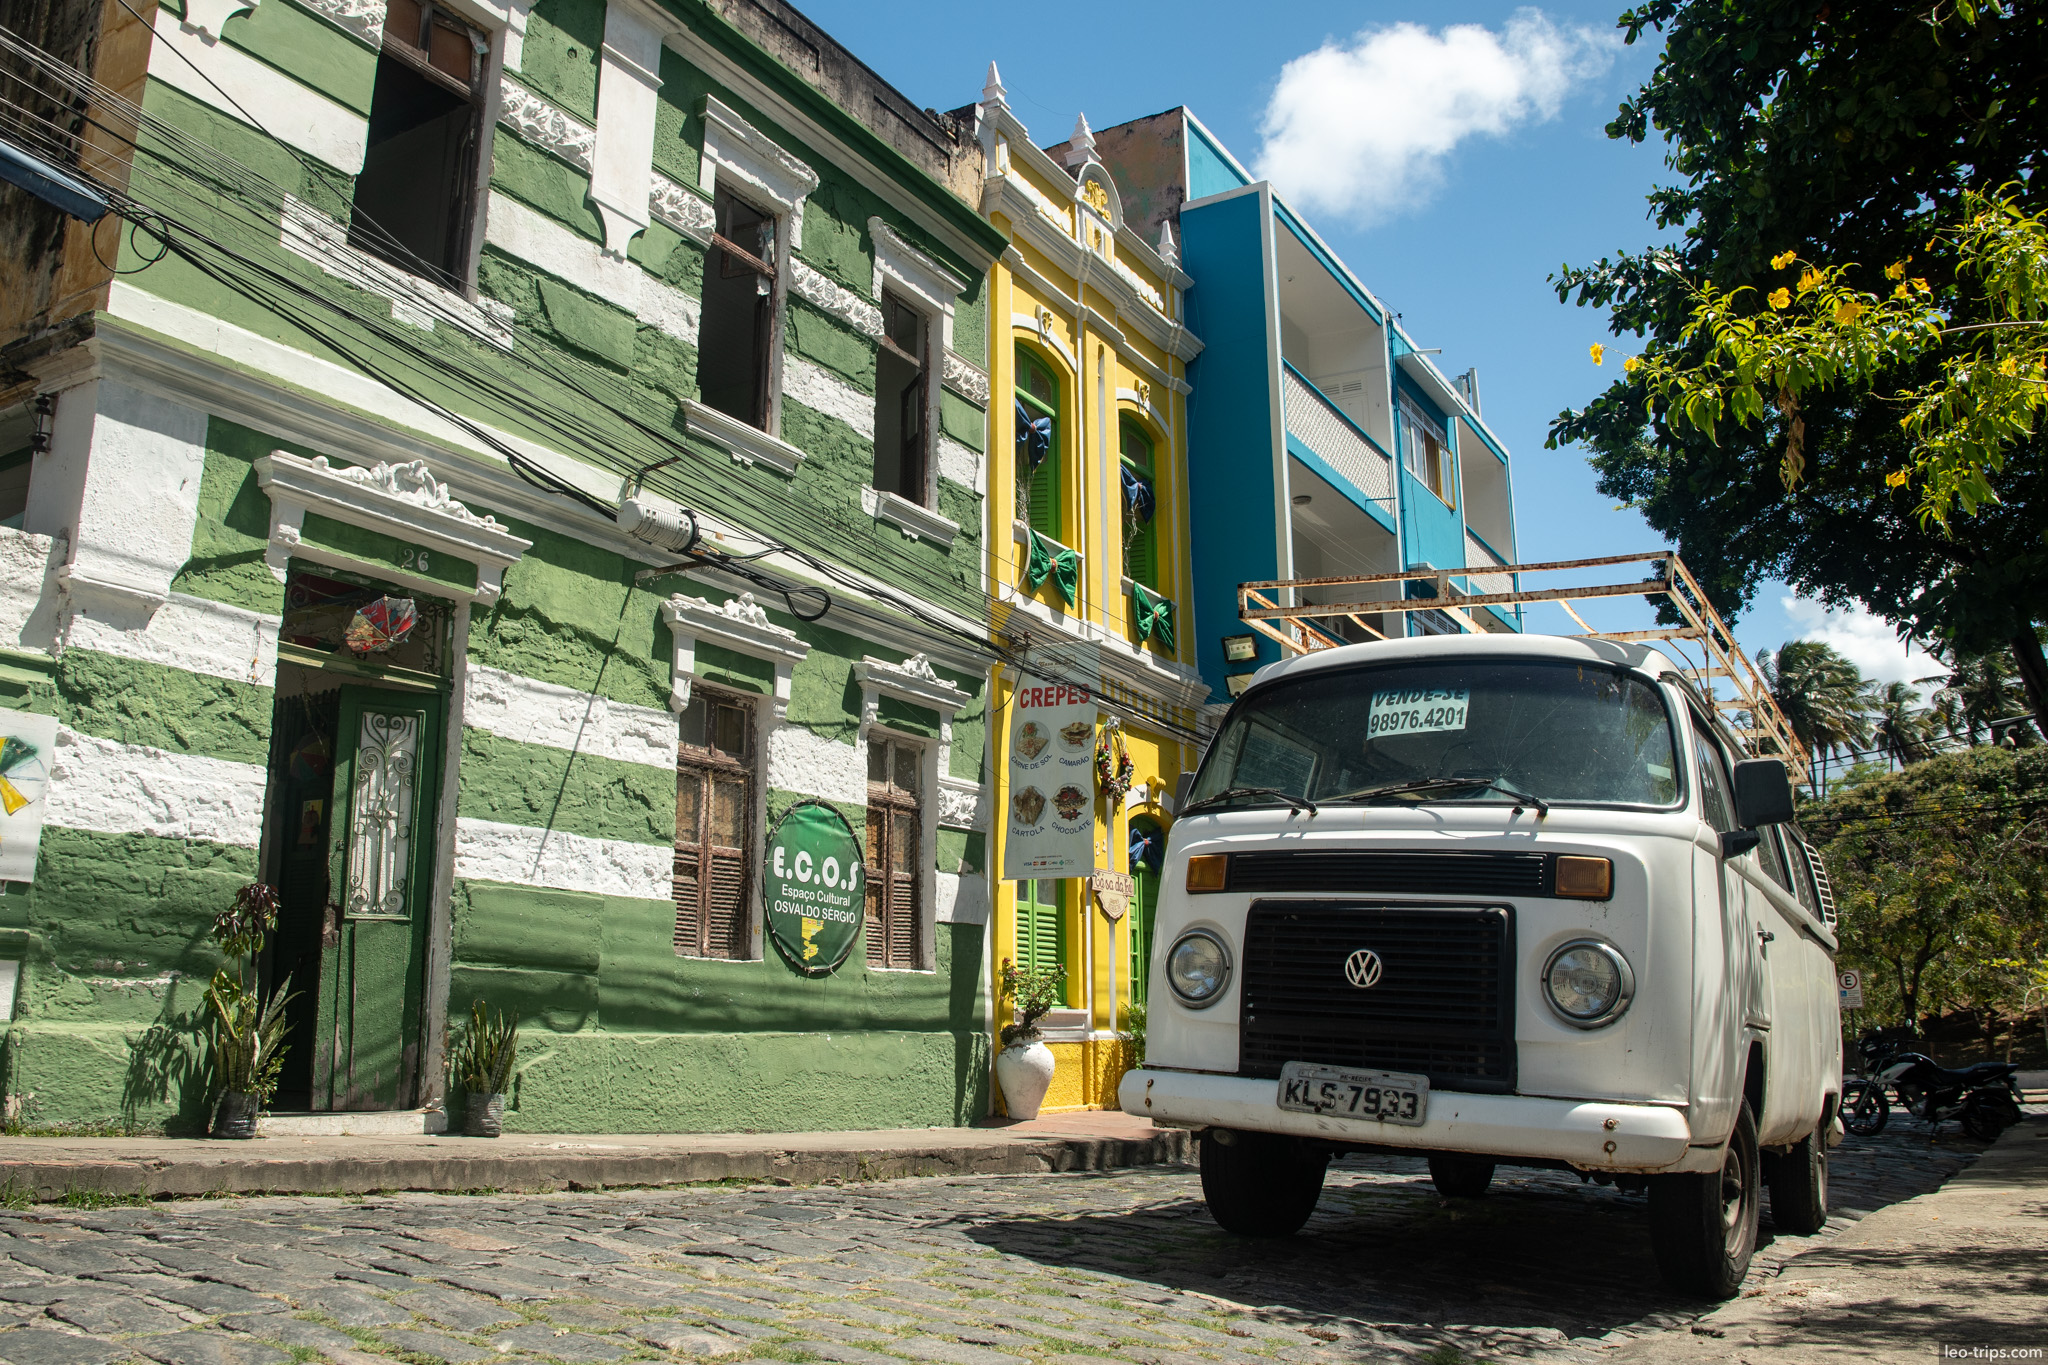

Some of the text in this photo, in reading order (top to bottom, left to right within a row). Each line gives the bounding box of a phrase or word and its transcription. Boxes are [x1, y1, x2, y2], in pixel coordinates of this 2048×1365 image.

[404, 548, 429, 572] 26
[1020, 683, 1091, 709] CREPES
[1375, 688, 1465, 707] VENDE-SE
[1370, 706, 1465, 734] 98976.4201
[1011, 753, 1053, 770] CARNE DE SOL
[1058, 755, 1090, 767] CAMARÃO
[1011, 825, 1045, 837] CARTOLA
[1051, 819, 1092, 835] CHOCOLATE
[782, 884, 851, 907] Espaço Cultural
[774, 900, 856, 924] OSVALDO SÉRGIO
[1844, 975, 1852, 986] E
